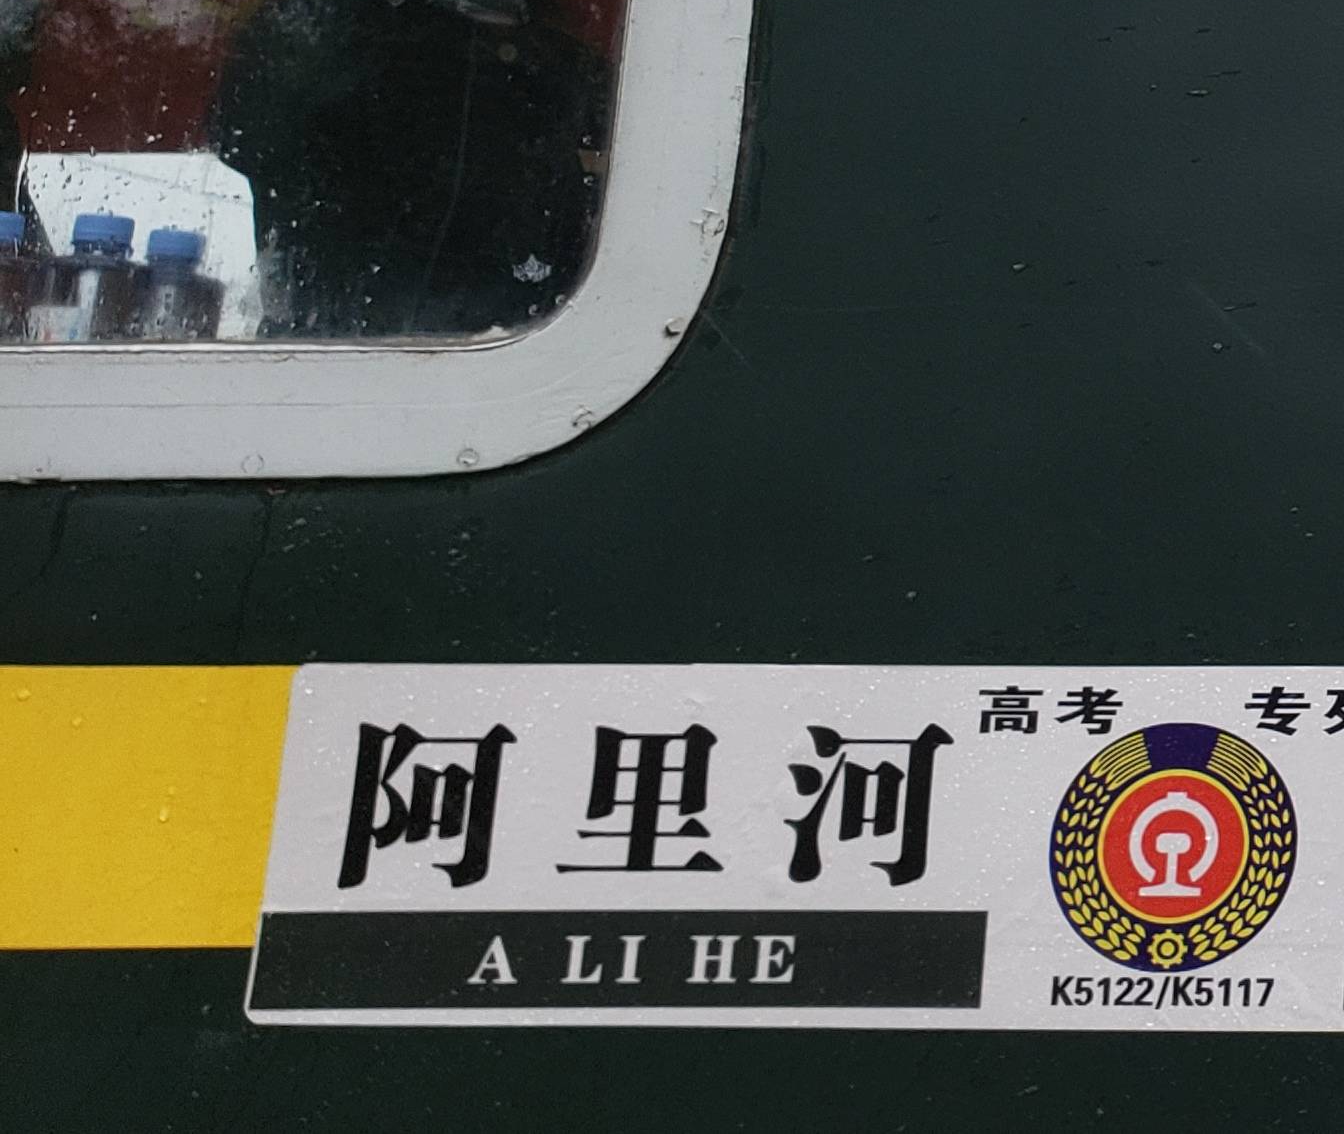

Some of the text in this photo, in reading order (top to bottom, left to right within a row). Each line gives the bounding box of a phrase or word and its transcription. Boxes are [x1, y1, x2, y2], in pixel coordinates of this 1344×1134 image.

[978, 685, 1123, 735] 高考
[337, 723, 955, 889] 阿里河
[467, 934, 797, 985] A LI HE
[1050, 975, 1275, 1008] K5122/K5117
